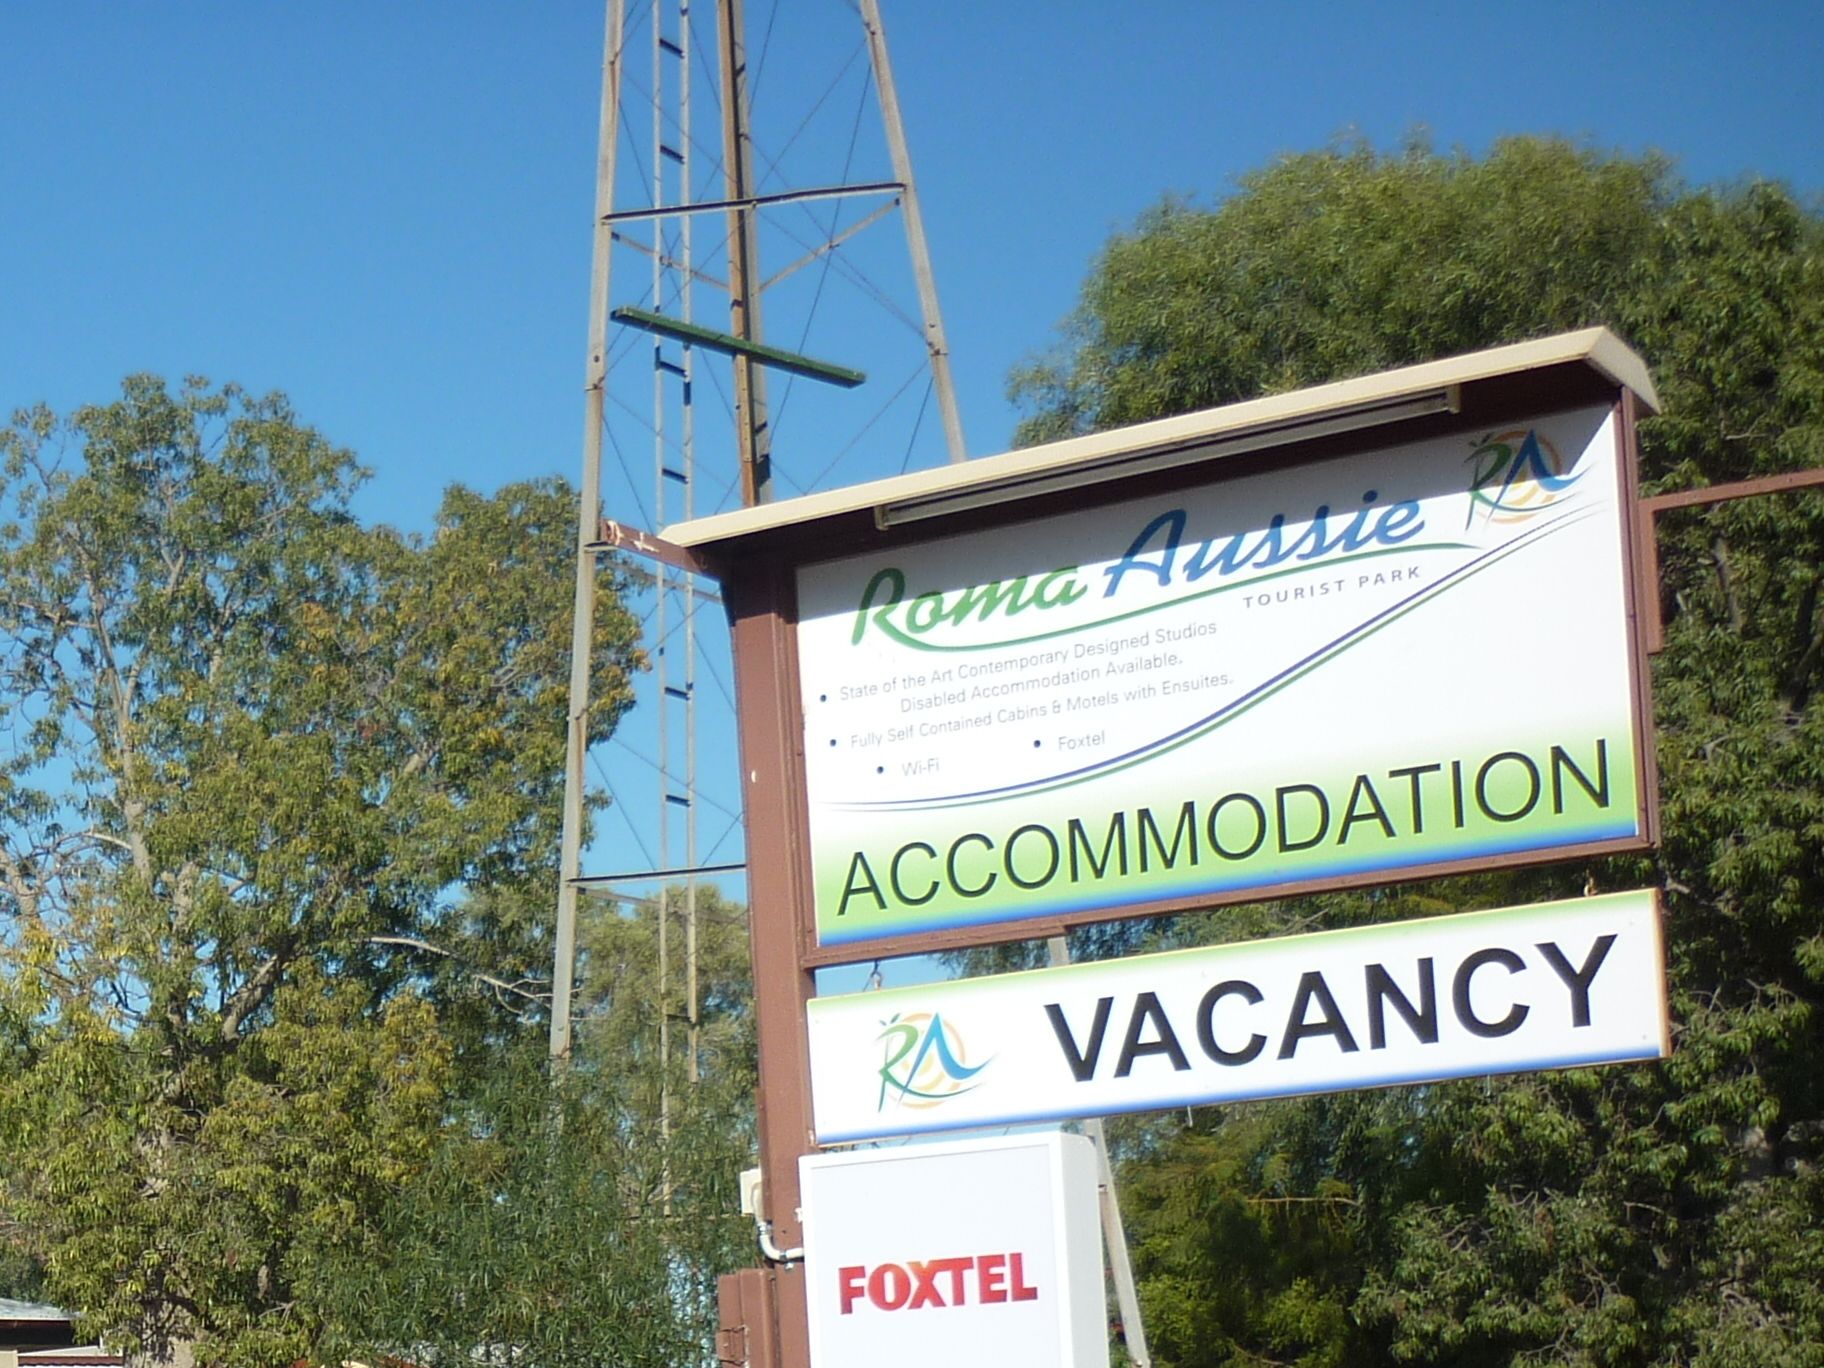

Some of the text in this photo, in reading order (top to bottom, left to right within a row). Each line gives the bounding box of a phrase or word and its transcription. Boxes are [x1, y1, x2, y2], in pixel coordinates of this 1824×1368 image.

[851, 490, 1425, 651] Roma Aussie
[1243, 565, 1421, 609] TOURIST PARK
[840, 622, 1217, 701] State of the Art Contemporary Designed Studios
[901, 652, 1183, 713] Disabled Accommodation Available.
[851, 732, 883, 749] Fully
[887, 725, 915, 743] Self
[919, 712, 992, 738] Contained
[997, 704, 1047, 723] Cabins
[1052, 700, 1061, 714] &
[1067, 691, 1119, 712] Motels
[1125, 684, 1157, 702] with
[1058, 730, 1106, 751] Foxtel
[902, 757, 940, 777] Wi-Fi
[838, 738, 1611, 916] ACCOMMODATION
[1044, 934, 1618, 1083] VACANCY
[838, 1252, 1038, 1315] FOXTEL
